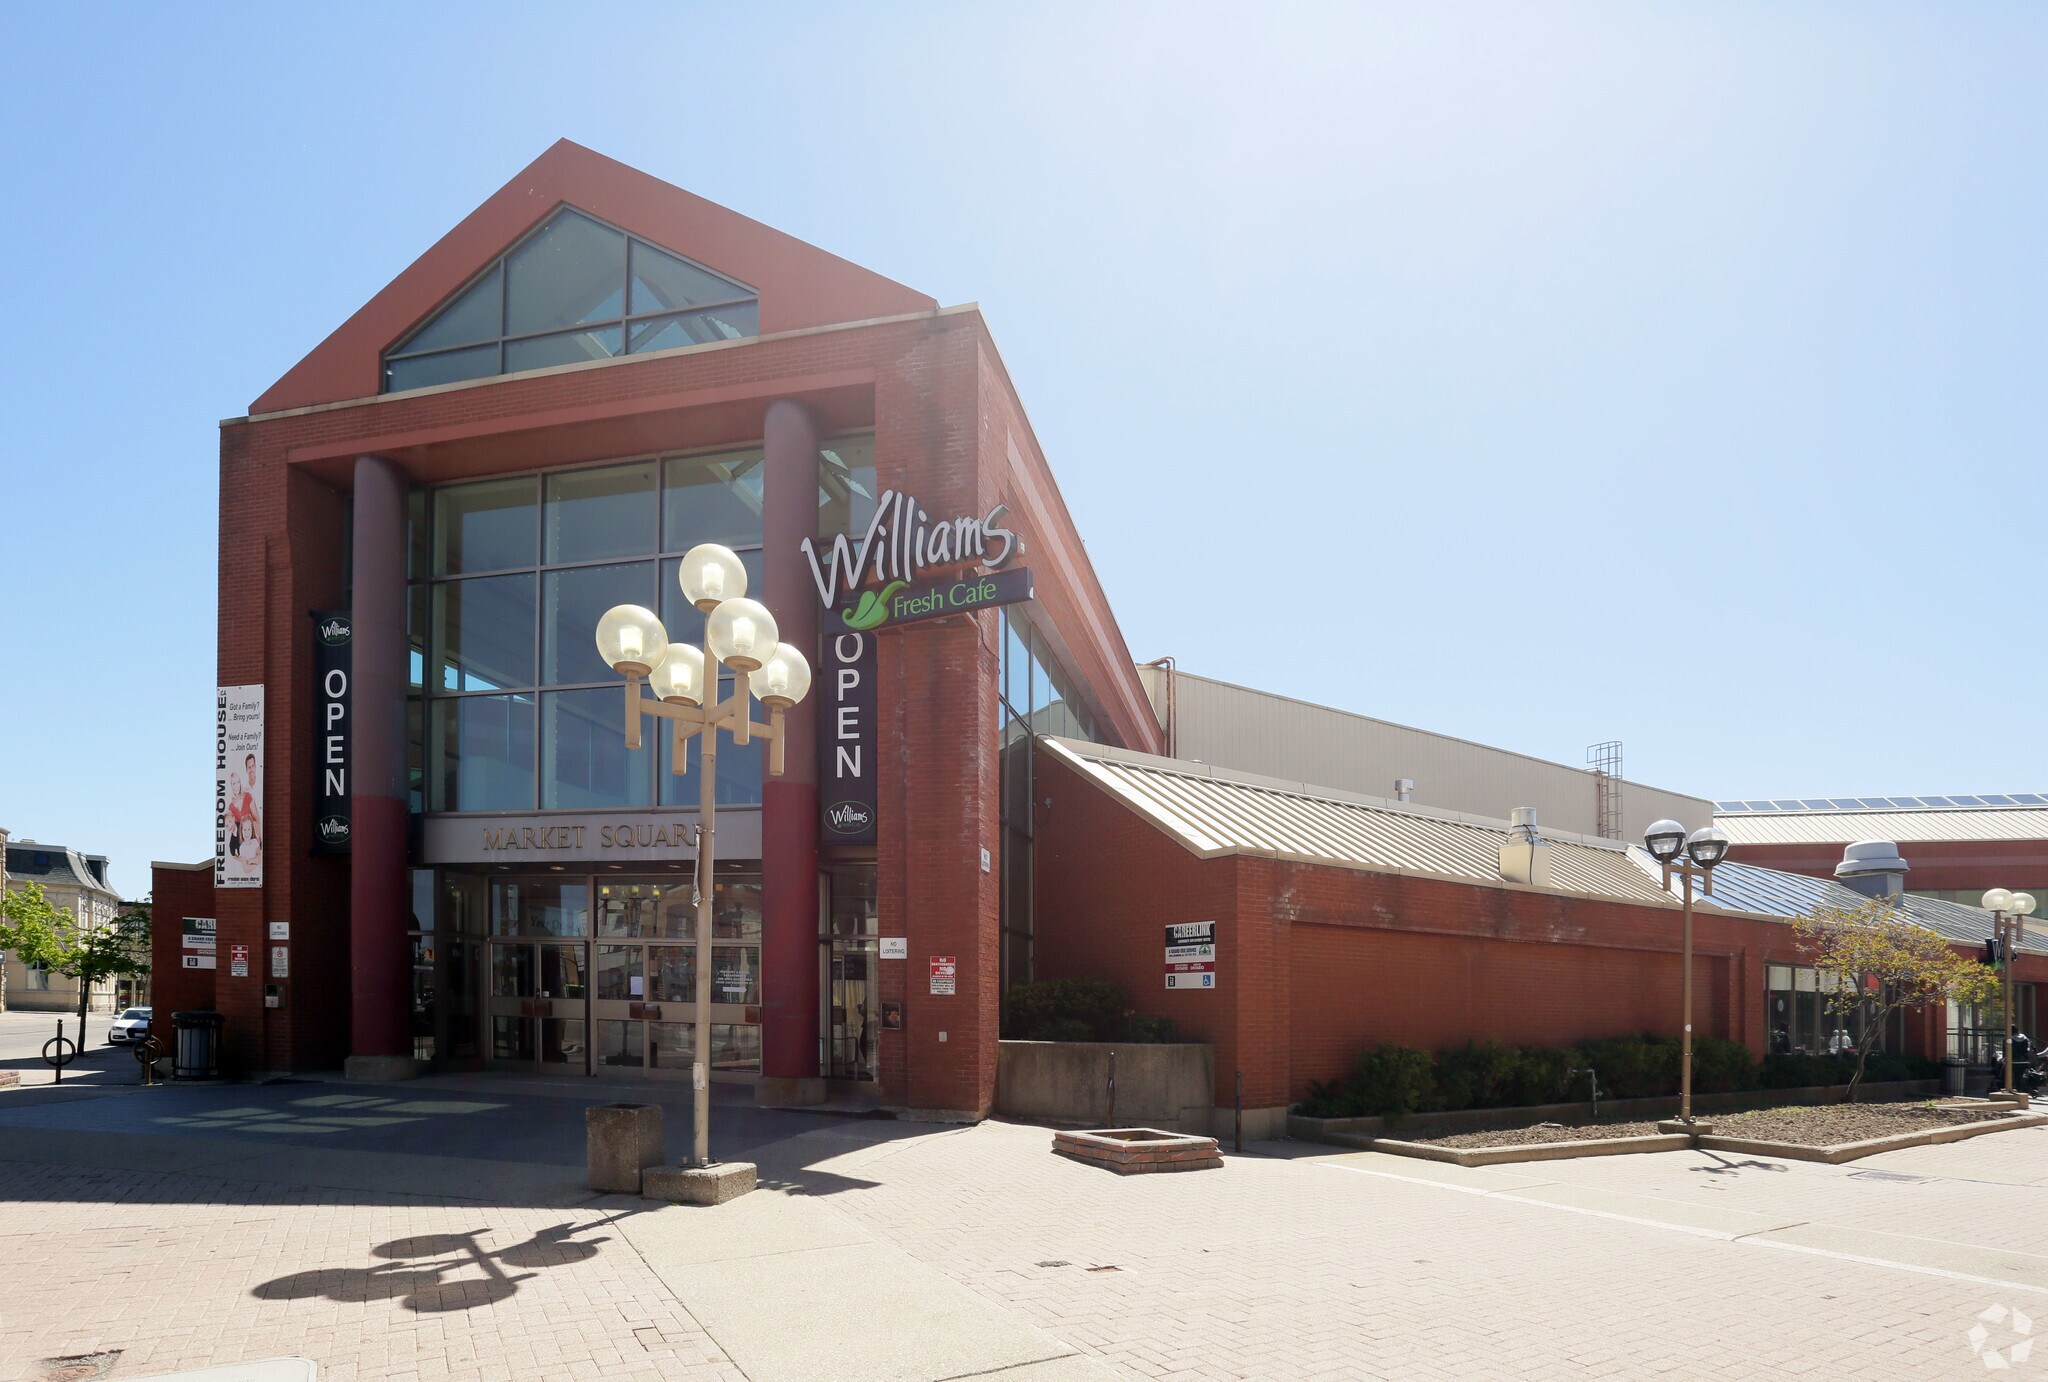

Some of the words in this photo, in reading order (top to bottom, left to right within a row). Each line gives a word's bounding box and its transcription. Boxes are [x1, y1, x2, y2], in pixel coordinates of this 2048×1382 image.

[801, 490, 1012, 609] Williams
[893, 587, 944, 618] Fresh
[949, 578, 997, 606] Cafe
[321, 620, 351, 639] Williams
[835, 632, 864, 778] OPEN
[325, 669, 347, 796] OPEN
[320, 818, 349, 836] Williams
[830, 804, 868, 825] Williams
[216, 780, 226, 885] FREEDOM
[483, 825, 586, 850] MARKET
[1174, 924, 1210, 938] CAREERLINK
